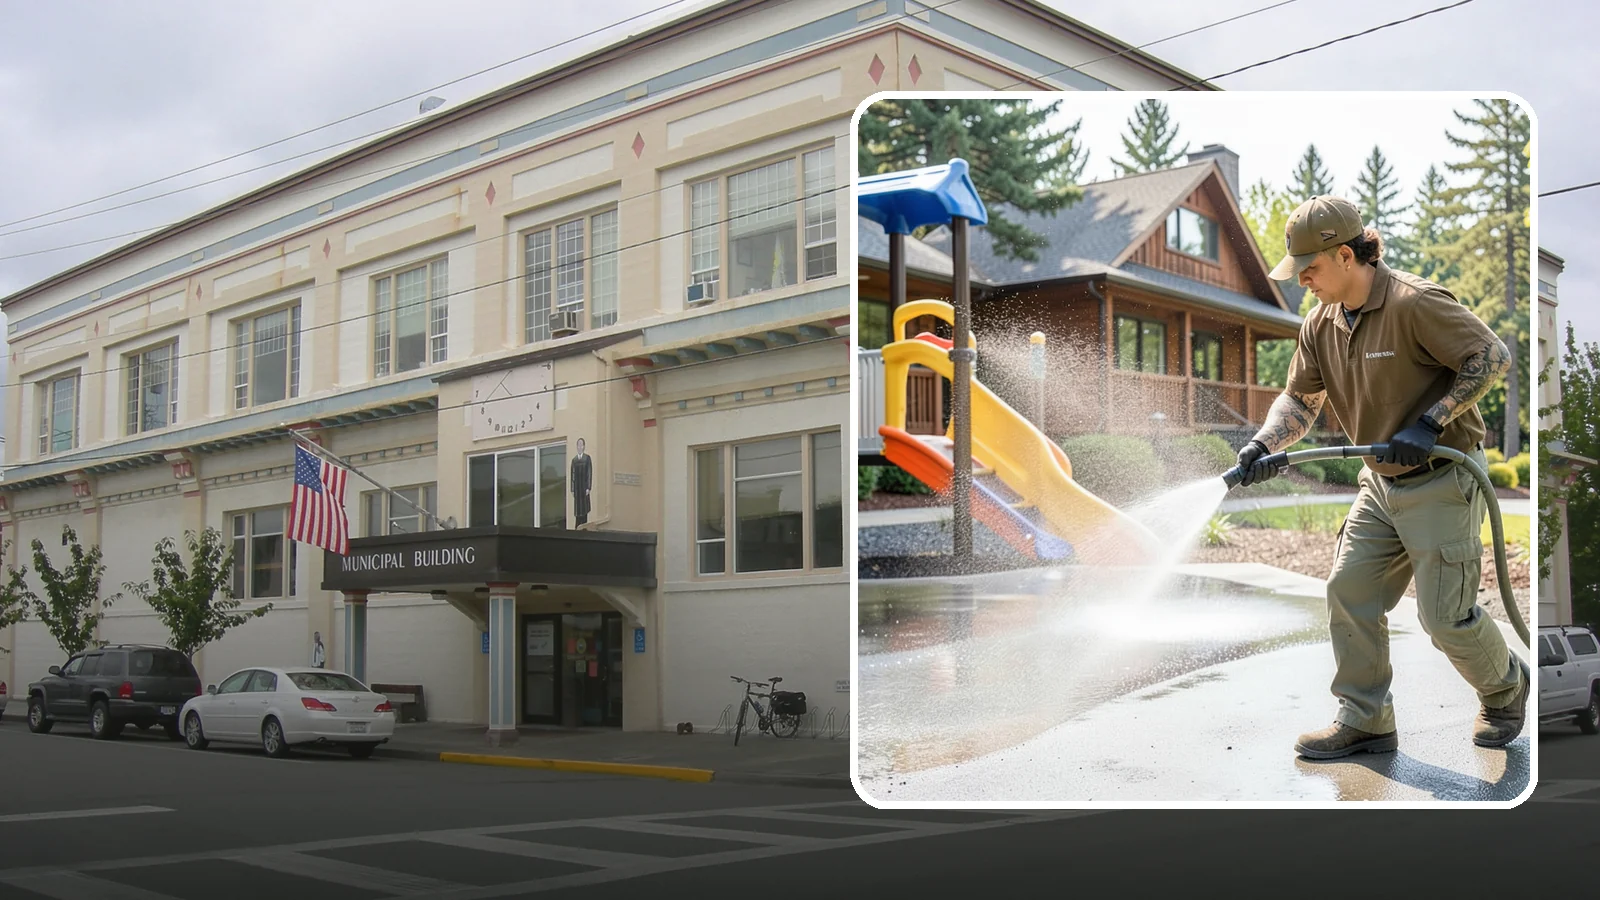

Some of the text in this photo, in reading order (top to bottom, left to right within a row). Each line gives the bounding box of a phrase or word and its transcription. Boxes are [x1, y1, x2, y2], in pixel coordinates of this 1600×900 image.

[488, 418, 492, 426] 9
[494, 423, 500, 432] 10
[507, 425, 513, 433] 12
[521, 420, 525, 428] 2
[536, 402, 540, 410] 4
[342, 546, 475, 572] MUNICIPAL BUILDING
